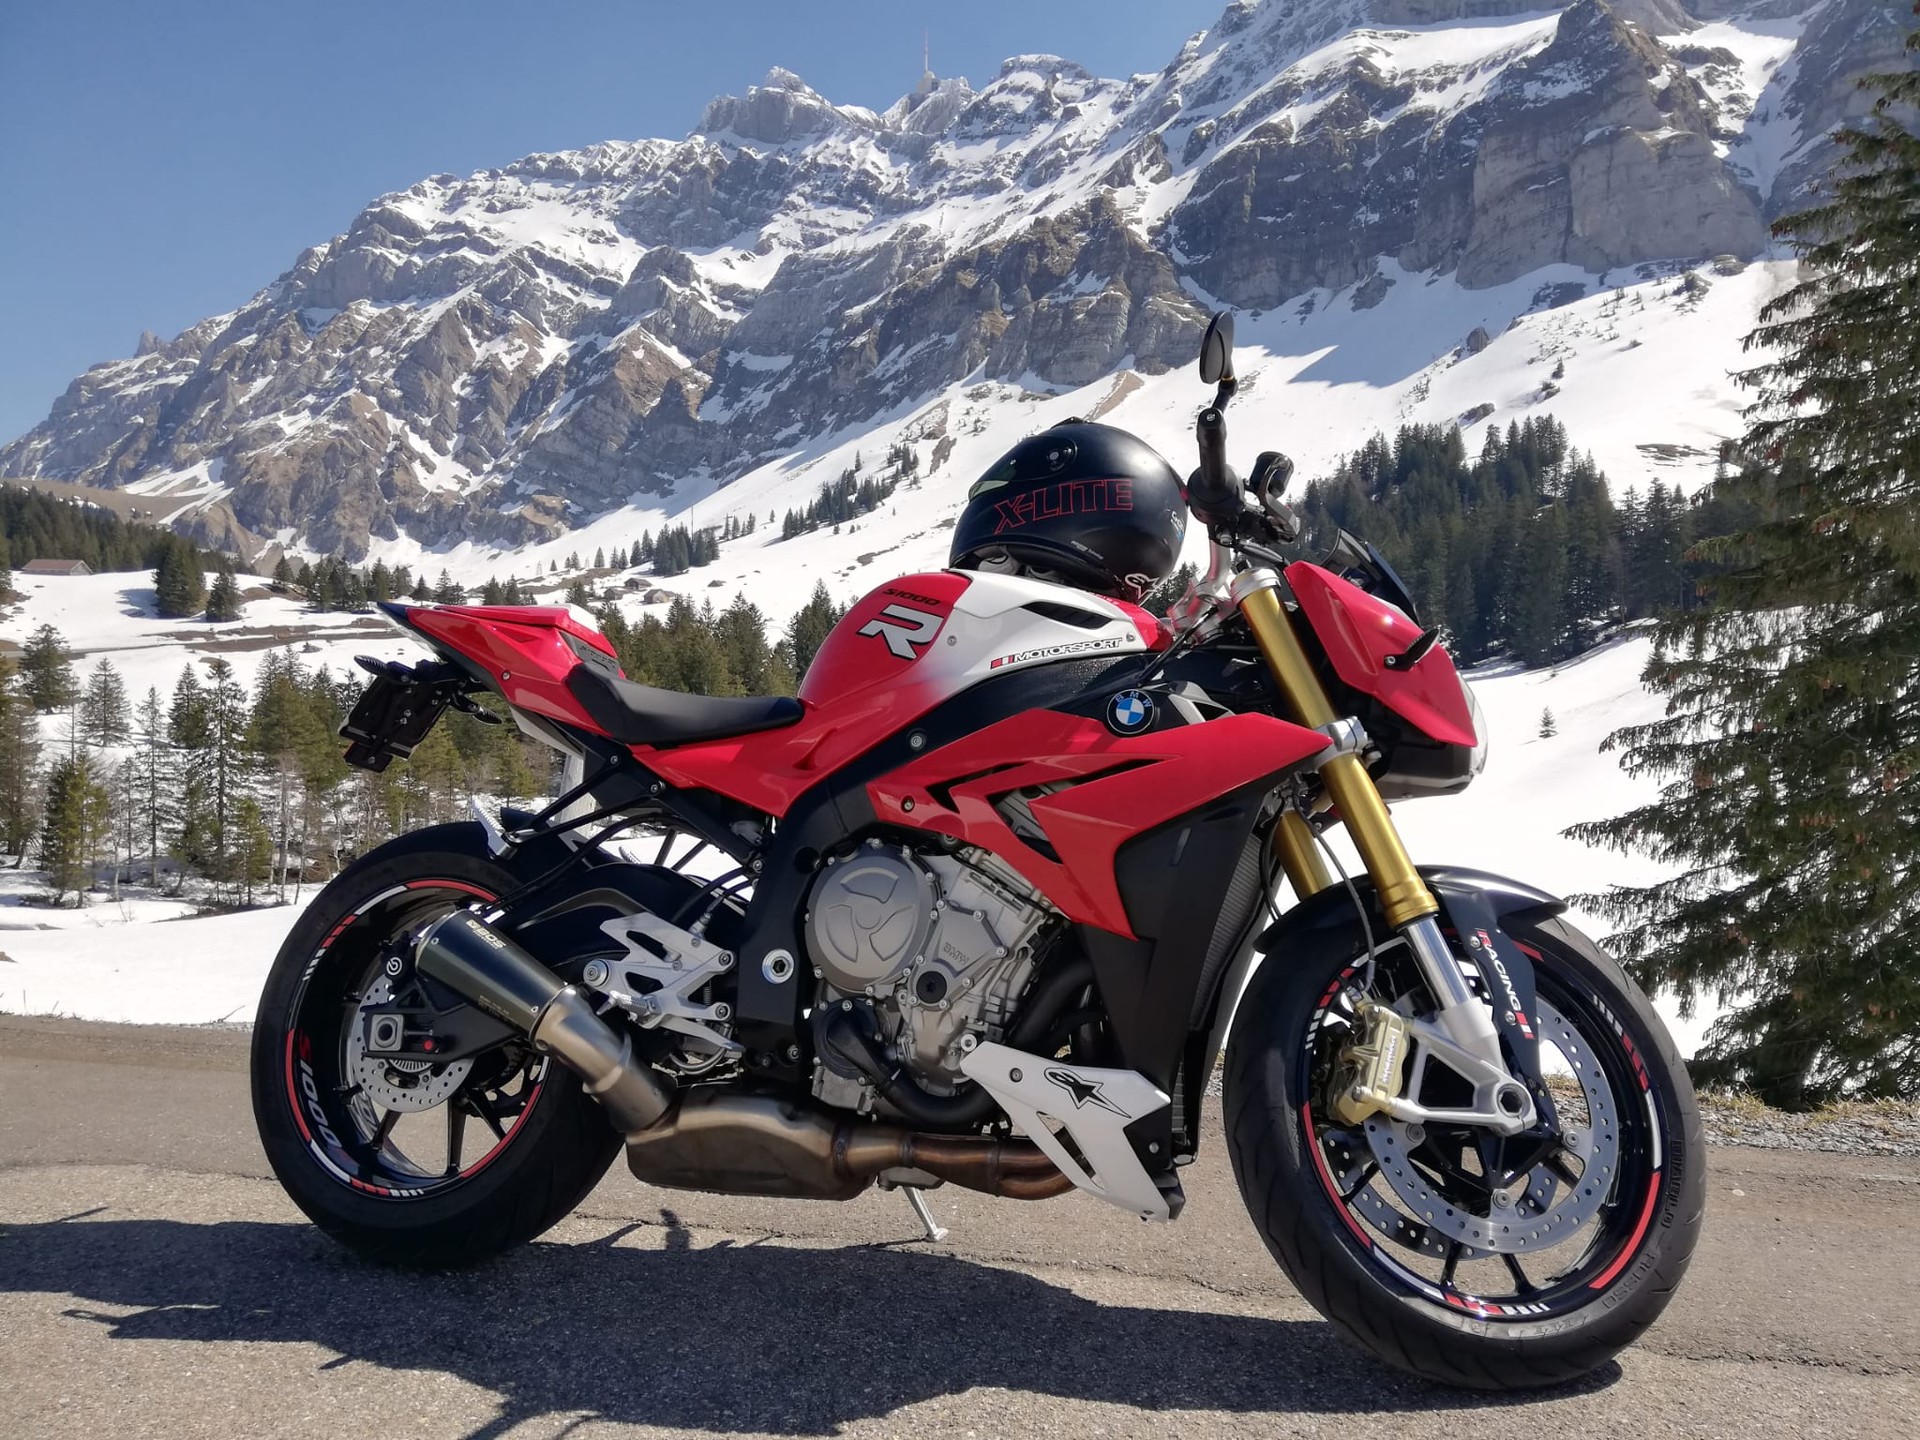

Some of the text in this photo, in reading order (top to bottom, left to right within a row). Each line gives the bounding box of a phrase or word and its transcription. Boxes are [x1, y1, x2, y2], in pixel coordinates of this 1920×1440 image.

[993, 478, 1134, 536] X-LITE
[882, 588, 941, 606] S1000
[855, 602, 945, 662] R
[1013, 636, 1123, 663] MOTORSPORT
[1115, 690, 1153, 709] BMW
[1476, 929, 1522, 1012] RACING
